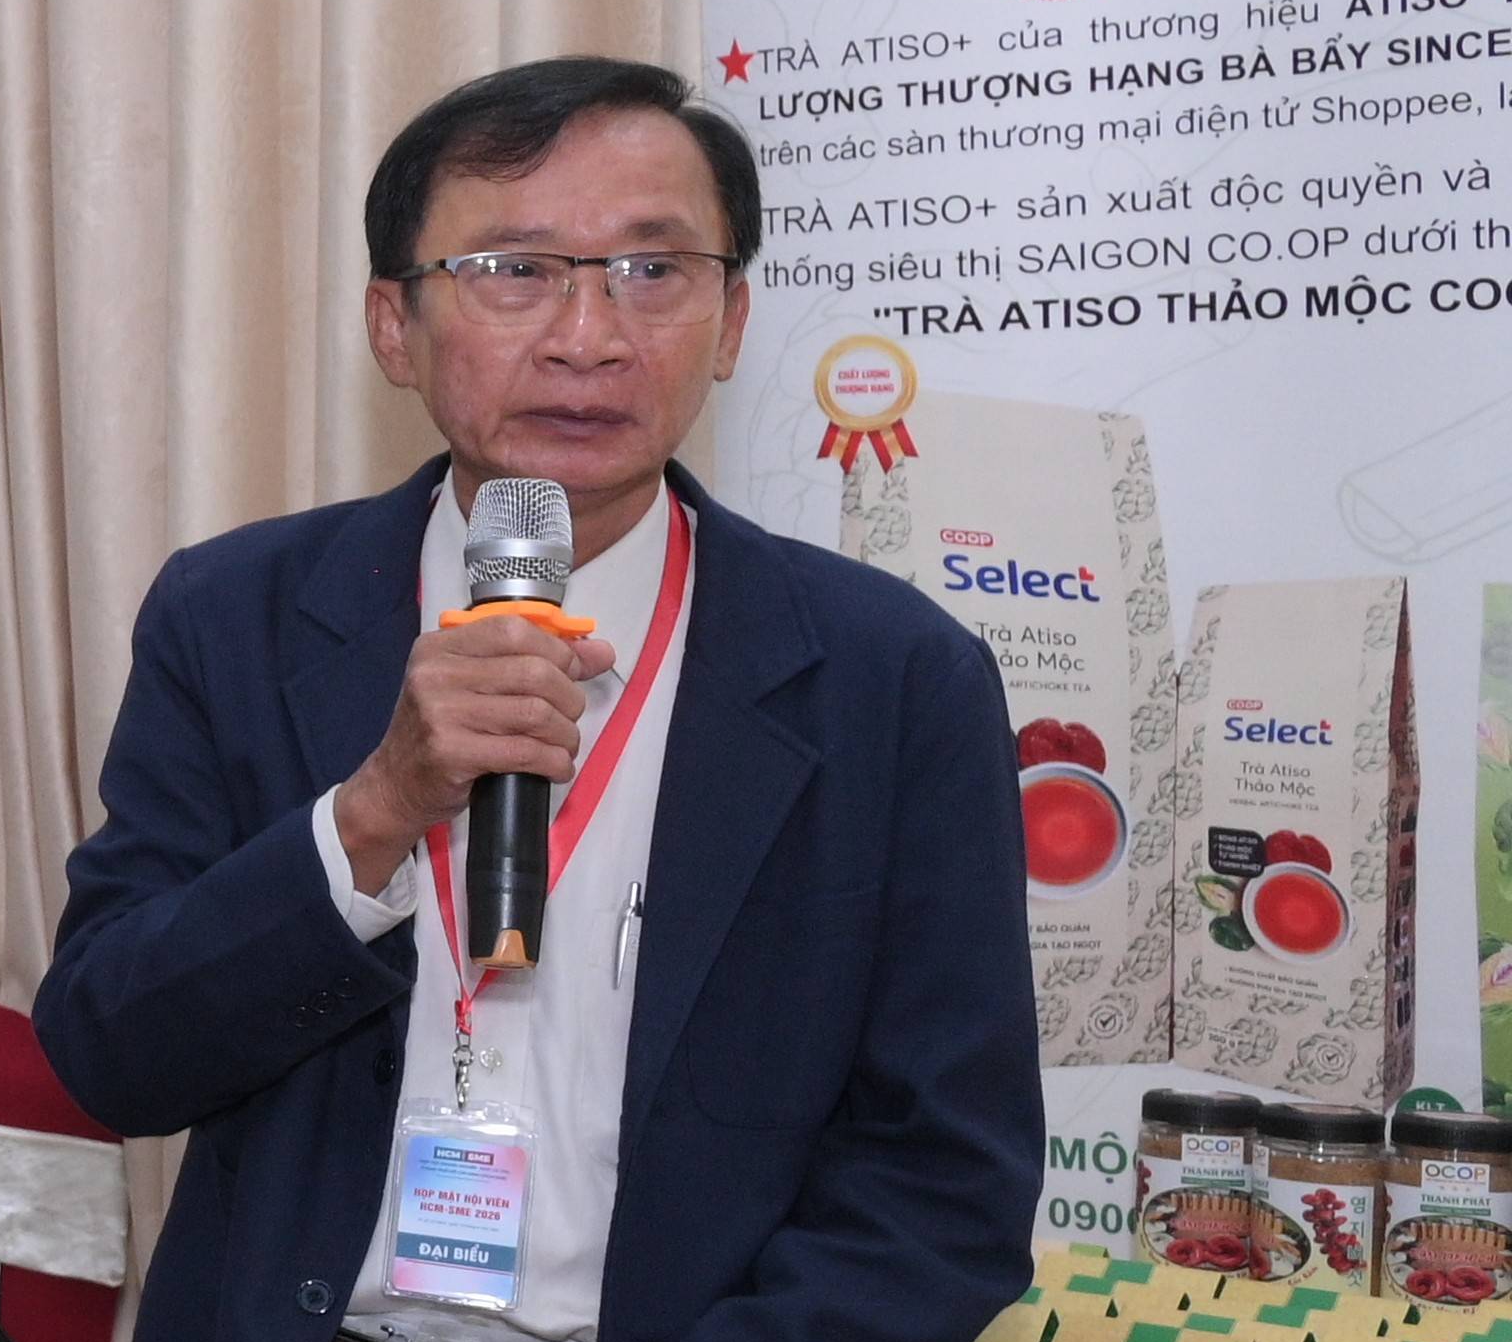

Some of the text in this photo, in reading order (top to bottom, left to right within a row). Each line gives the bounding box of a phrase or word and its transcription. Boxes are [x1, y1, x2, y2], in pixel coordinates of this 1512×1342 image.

[758, 39, 819, 74] TRÀ
[841, 31, 972, 67] ATISO+
[998, 20, 1063, 51] của
[1090, 12, 1219, 43] thương
[760, 86, 883, 122] LƯỢNG
[898, 70, 1072, 107] THƯỢNG
[1089, 58, 1204, 97] HẠNG
[1221, 45, 1275, 81] BÀ
[760, 91, 1482, 167] trên các sàn thương mại điện tử Shoppee,
[763, 159, 1492, 235] TRÀ ATISO+ sản xuất độc quyền và
[763, 218, 1457, 291] thống siêu thị SAIGON CO.OP dưới
[1000, 294, 1142, 332] ATISO
[1158, 279, 1289, 324] THẢO
[1305, 275, 1412, 324] MỘC
[943, 531, 991, 546] COOP
[943, 554, 1101, 603] Select
[975, 621, 1078, 647] Trà Atiso
[1224, 716, 1333, 746] Select
[1240, 761, 1311, 778] Trà Atiso
[1235, 778, 1316, 798] Thảo Mộc
[1186, 1138, 1241, 1153] OCOP
[1424, 1163, 1487, 1180] OCOP
[419, 1243, 490, 1264] ĐẠI BIỂU
